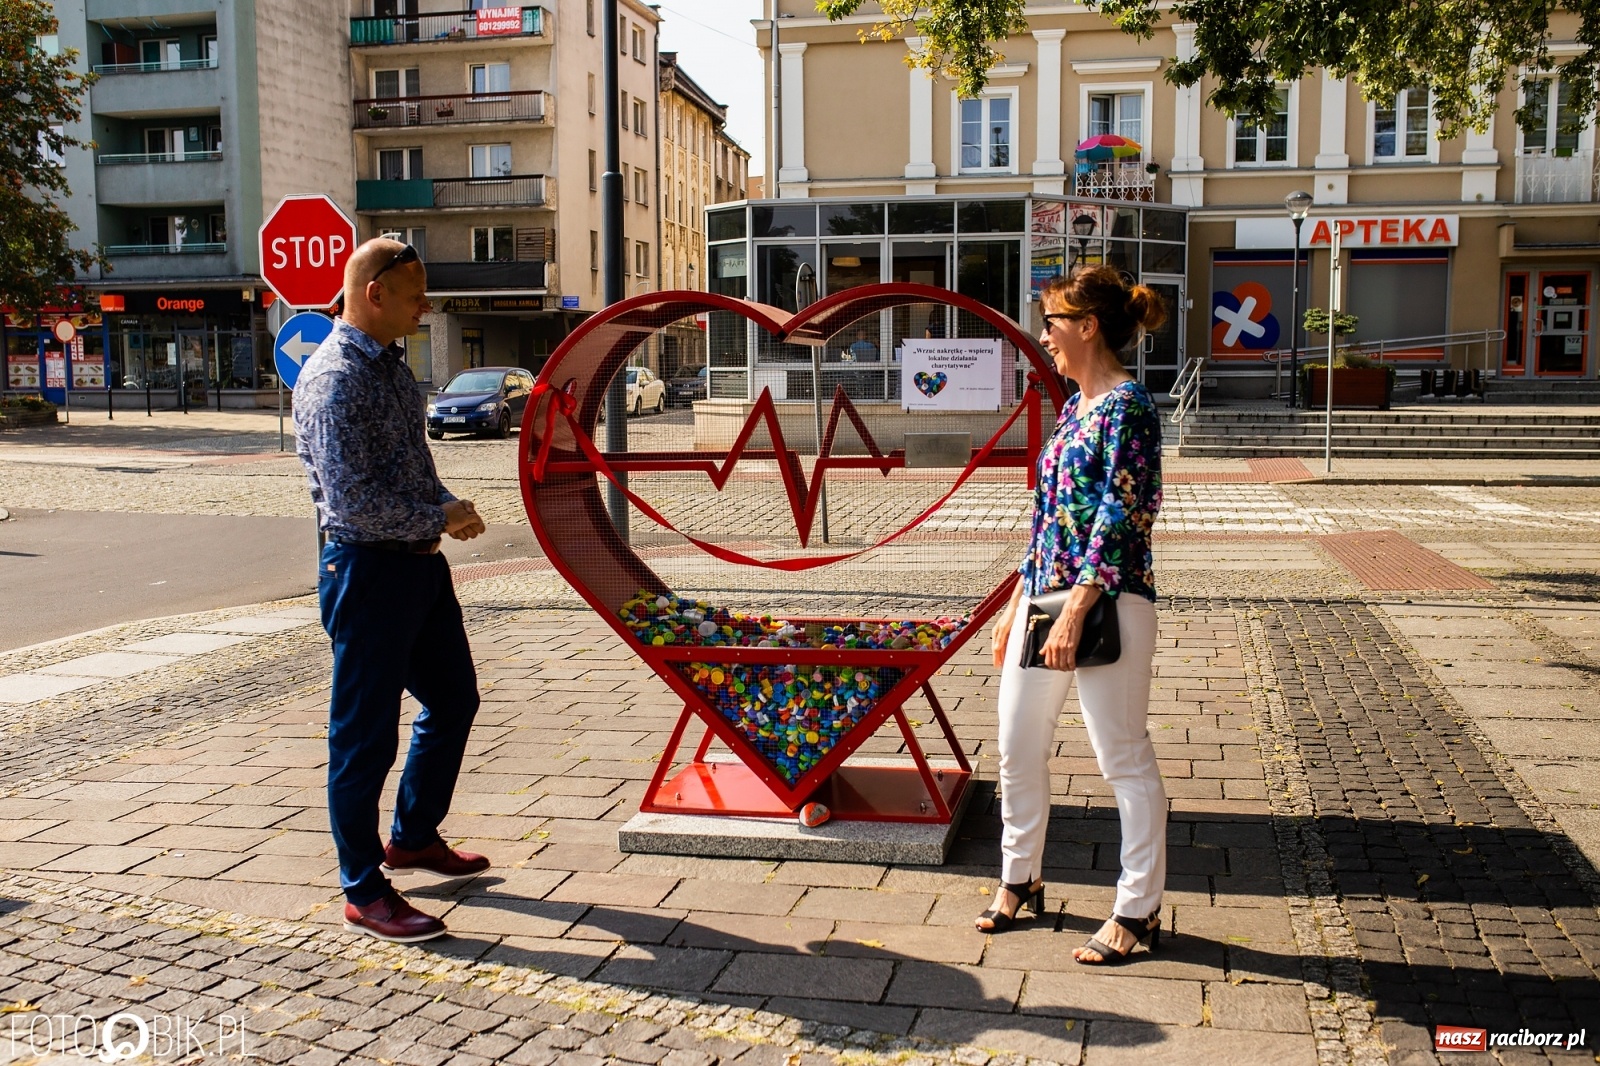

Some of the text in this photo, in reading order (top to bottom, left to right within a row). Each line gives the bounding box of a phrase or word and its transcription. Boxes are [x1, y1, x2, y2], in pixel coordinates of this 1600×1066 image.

[478, 7, 520, 19] WYNAJMĘ
[478, 20, 520, 31] 601299992
[1310, 218, 1452, 245] APTEKA
[271, 235, 346, 269] STOP
[157, 297, 205, 312] Orange
